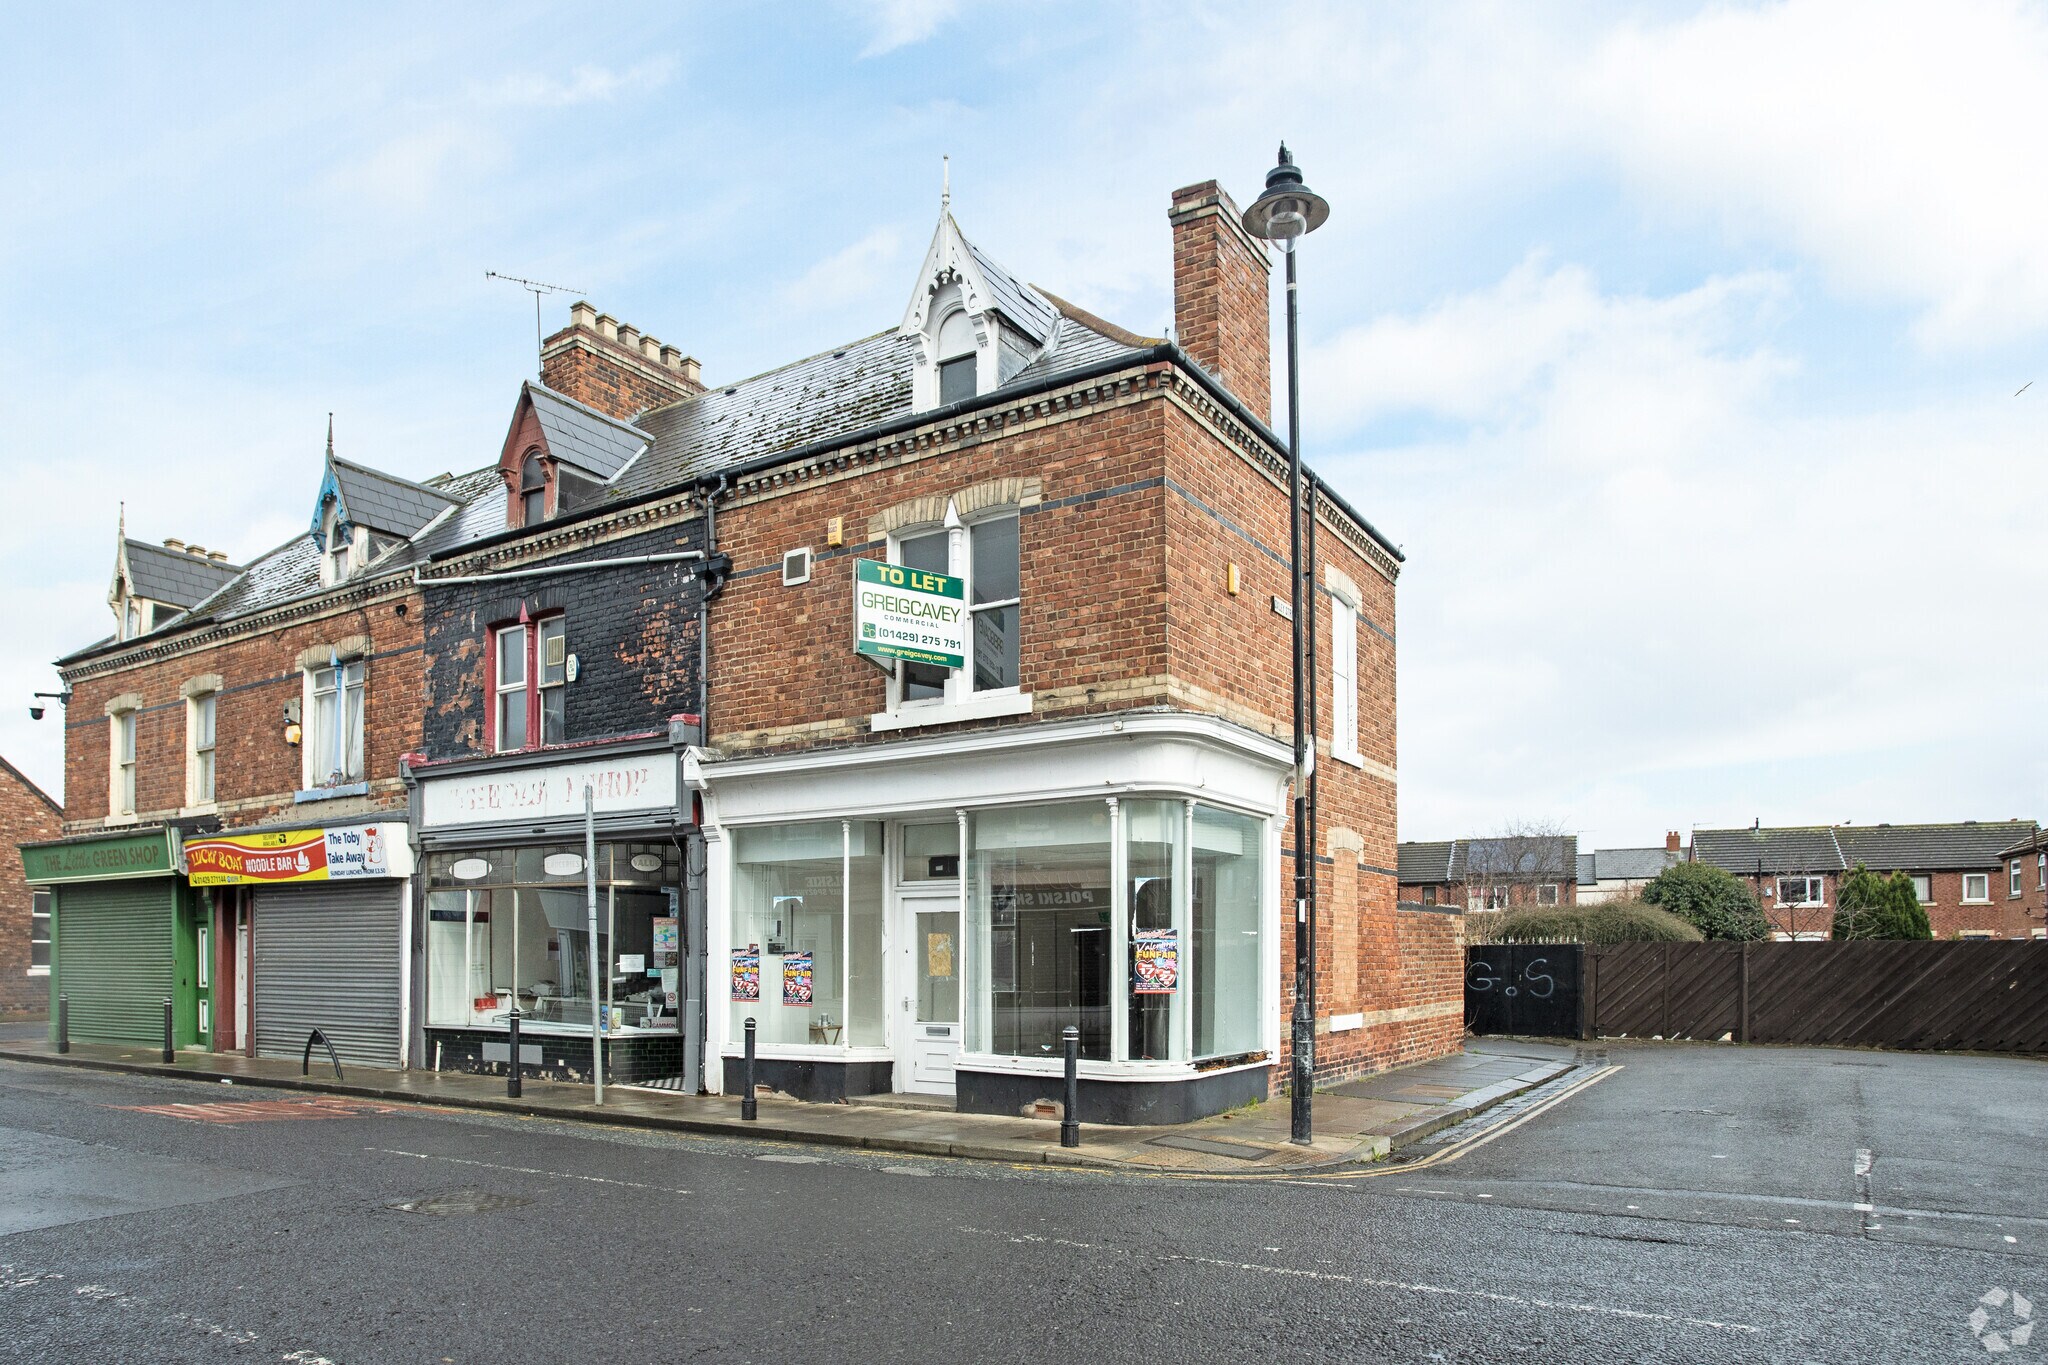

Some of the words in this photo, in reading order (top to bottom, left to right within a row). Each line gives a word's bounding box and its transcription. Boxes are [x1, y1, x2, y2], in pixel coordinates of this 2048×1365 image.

[877, 566, 904, 585] TO
[911, 572, 947, 592] LET
[862, 591, 961, 623] GREIGCAVEY
[884, 614, 940, 628] COMMERCIAL
[879, 627, 919, 643] (01429)
[922, 635, 941, 646] 275
[943, 639, 961, 649] 791
[877, 646, 947, 662] www.greigcavey.com
[328, 833, 341, 844] The
[343, 831, 360, 845] Toby
[44, 854, 61, 872] THE
[63, 847, 91, 871] Little
[93, 847, 128, 868] GREEN
[130, 845, 159, 865] SHOP
[191, 848, 217, 866] LUCKY
[218, 851, 243, 871] BOAT
[245, 857, 276, 873] NOODLE
[276, 856, 293, 871] BAR
[327, 853, 344, 864] Take
[345, 851, 365, 865] Away
[1136, 950, 1177, 959] FUNFAIR
[1139, 967, 1156, 975] 17
